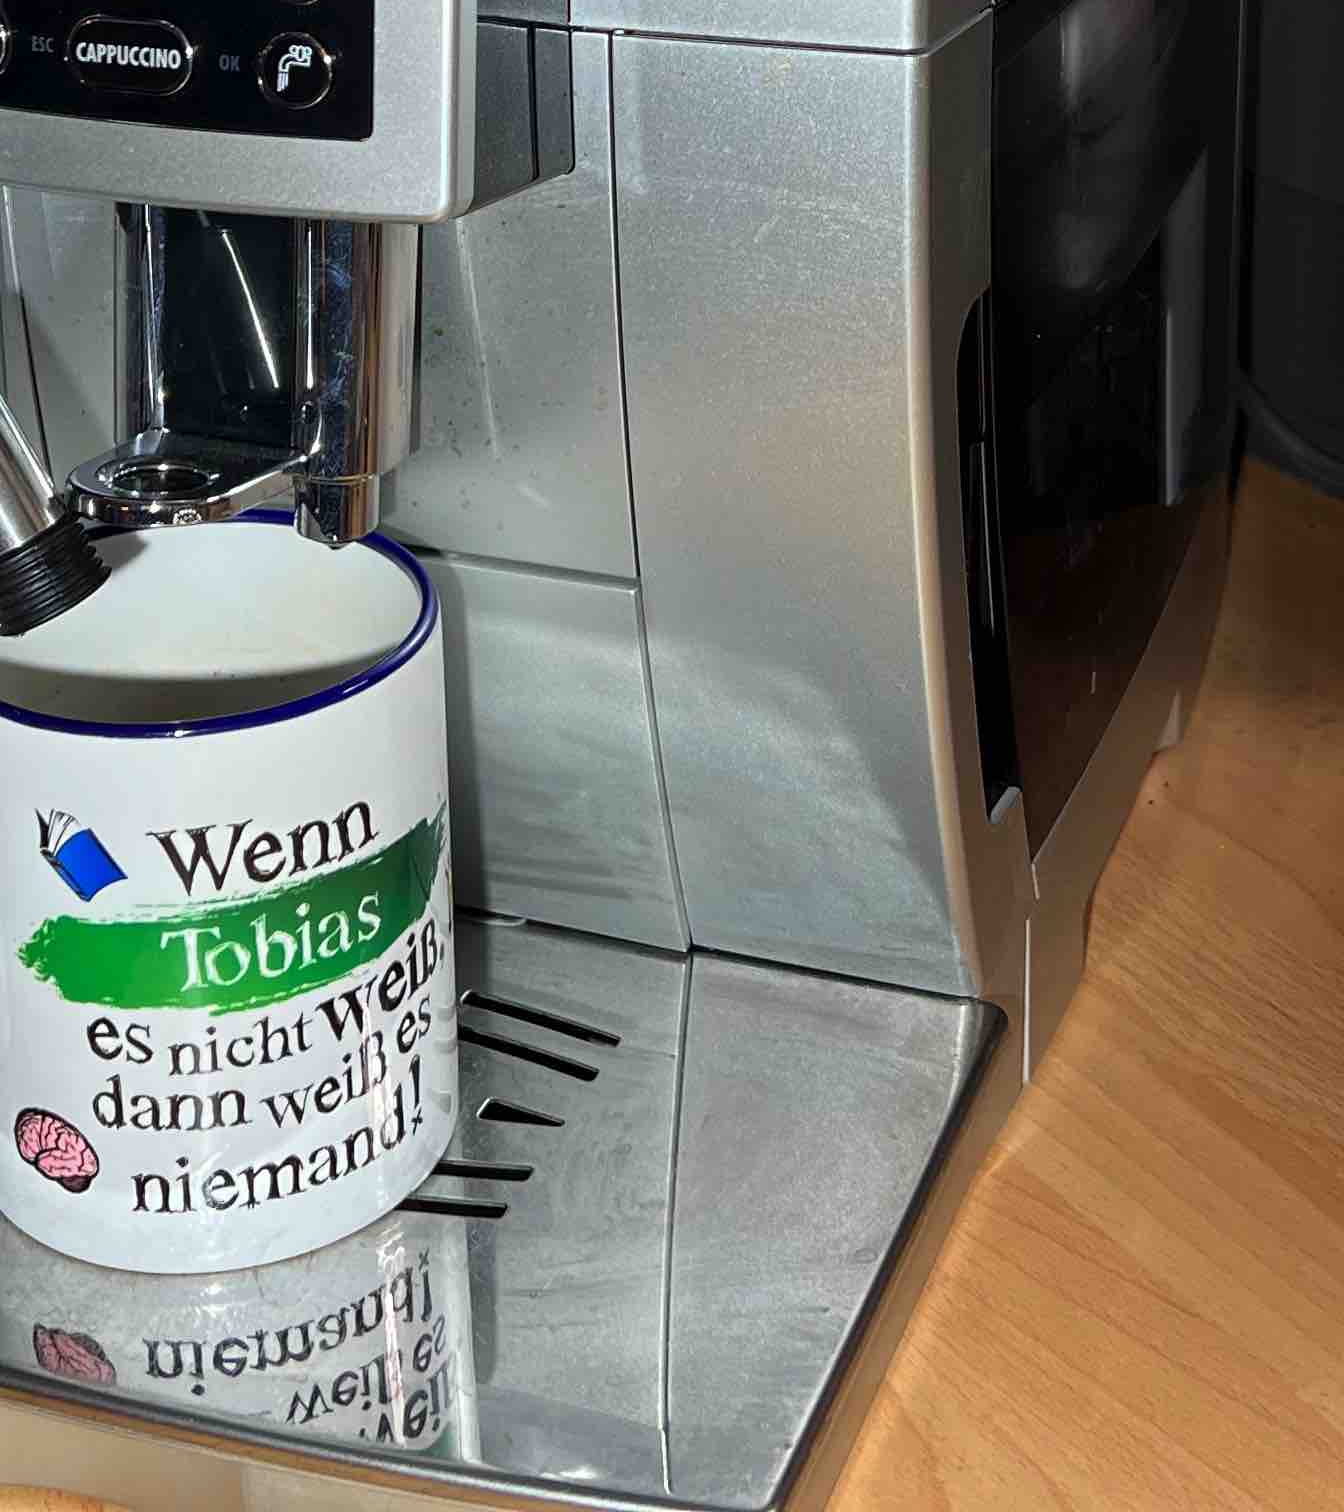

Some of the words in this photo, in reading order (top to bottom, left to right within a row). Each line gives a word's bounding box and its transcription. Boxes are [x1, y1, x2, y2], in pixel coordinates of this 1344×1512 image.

[31, 35, 55, 54] ESC
[75, 41, 182, 70] CAPPUCCINO
[218, 54, 241, 71] OK
[146, 799, 379, 895] Wenn
[160, 890, 383, 992] Tobias
[86, 1017, 154, 1065] es
[168, 1007, 313, 1078] nicht
[91, 1073, 252, 1131] dann
[260, 1030, 387, 1130] weiß
[396, 994, 432, 1054] es
[130, 1053, 424, 1214] niemand!
